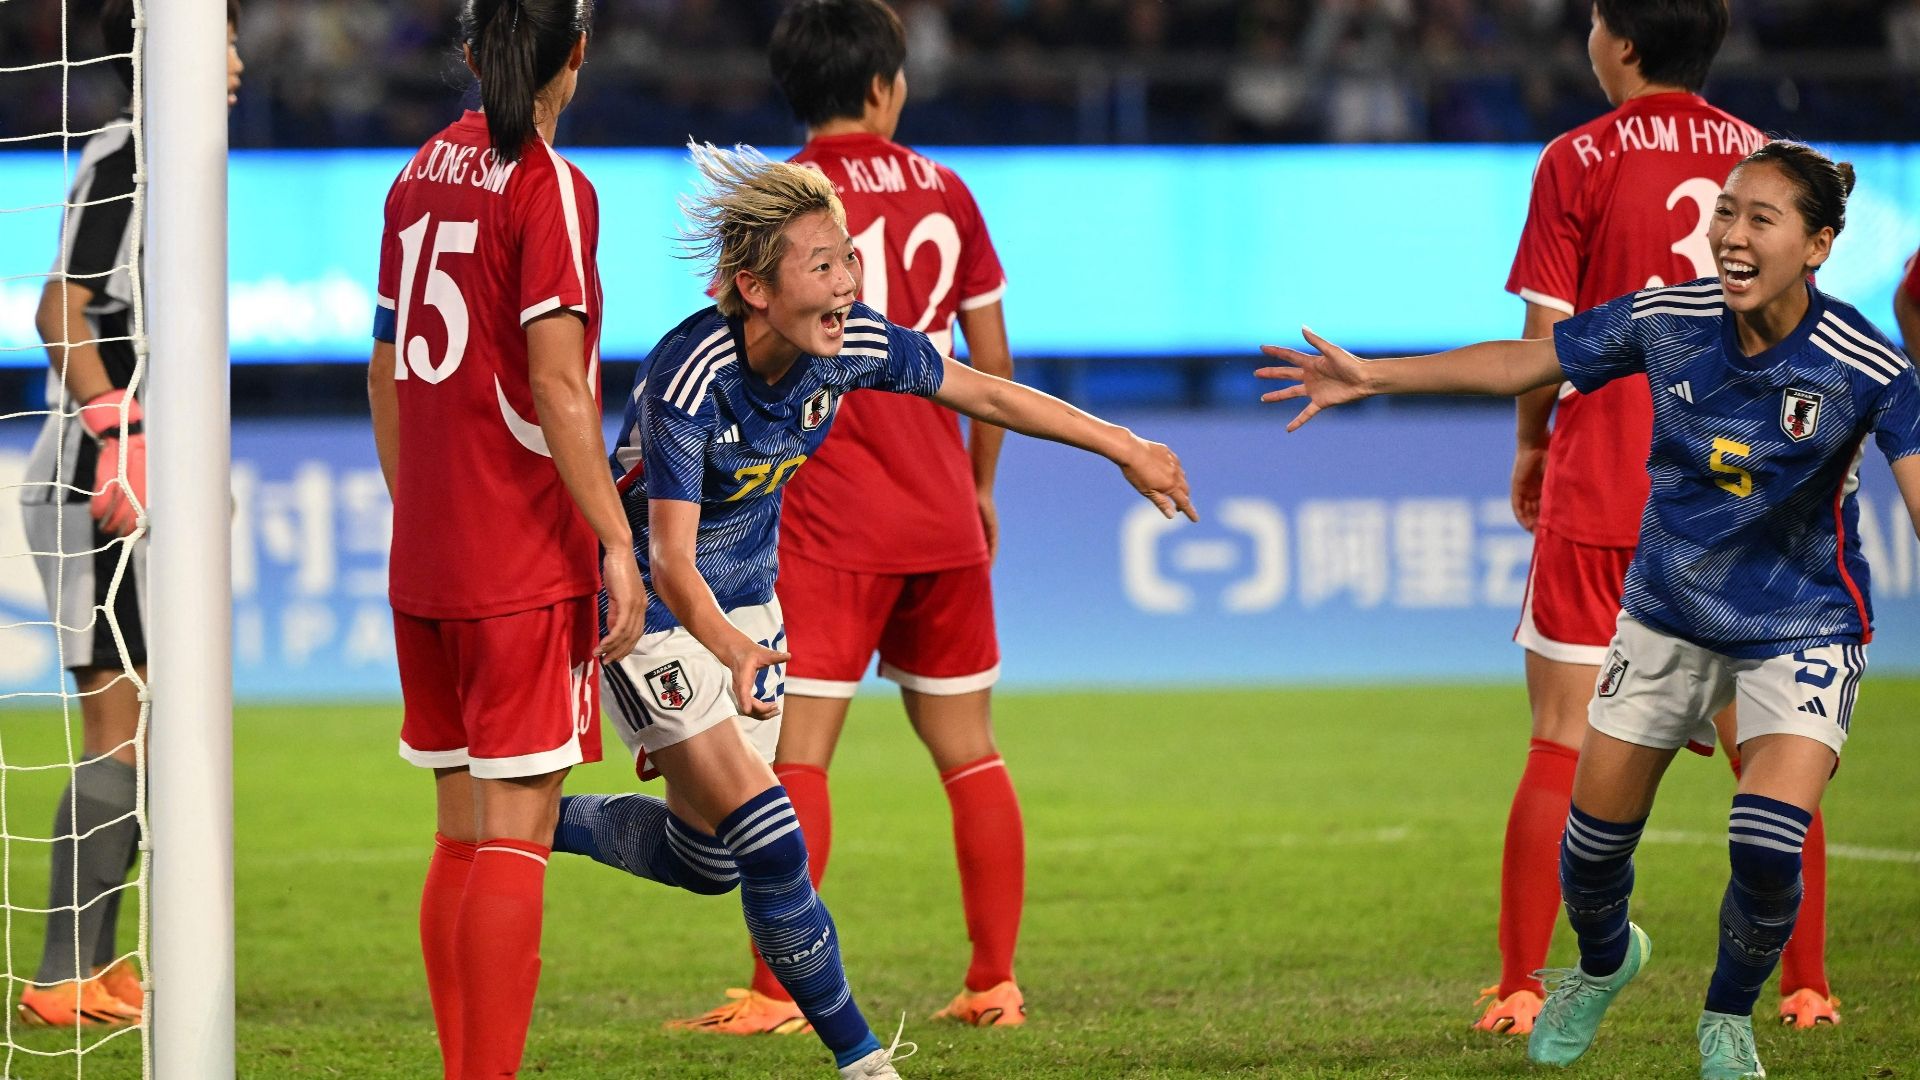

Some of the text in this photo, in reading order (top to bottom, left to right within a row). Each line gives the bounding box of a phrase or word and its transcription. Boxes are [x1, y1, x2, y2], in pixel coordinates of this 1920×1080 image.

[416, 139, 478, 185] JONG
[470, 147, 518, 195] SIM
[1572, 133, 1616, 168] R.
[1615, 115, 1680, 153] KUM
[841, 154, 907, 193] KUM
[907, 153, 947, 193] OK
[1645, 176, 1723, 288] 3
[393, 211, 479, 385] 15
[851, 212, 962, 333] 12
[1709, 436, 1752, 498] 5
[1793, 648, 1838, 690] 5
[765, 925, 830, 965] JAPAN
